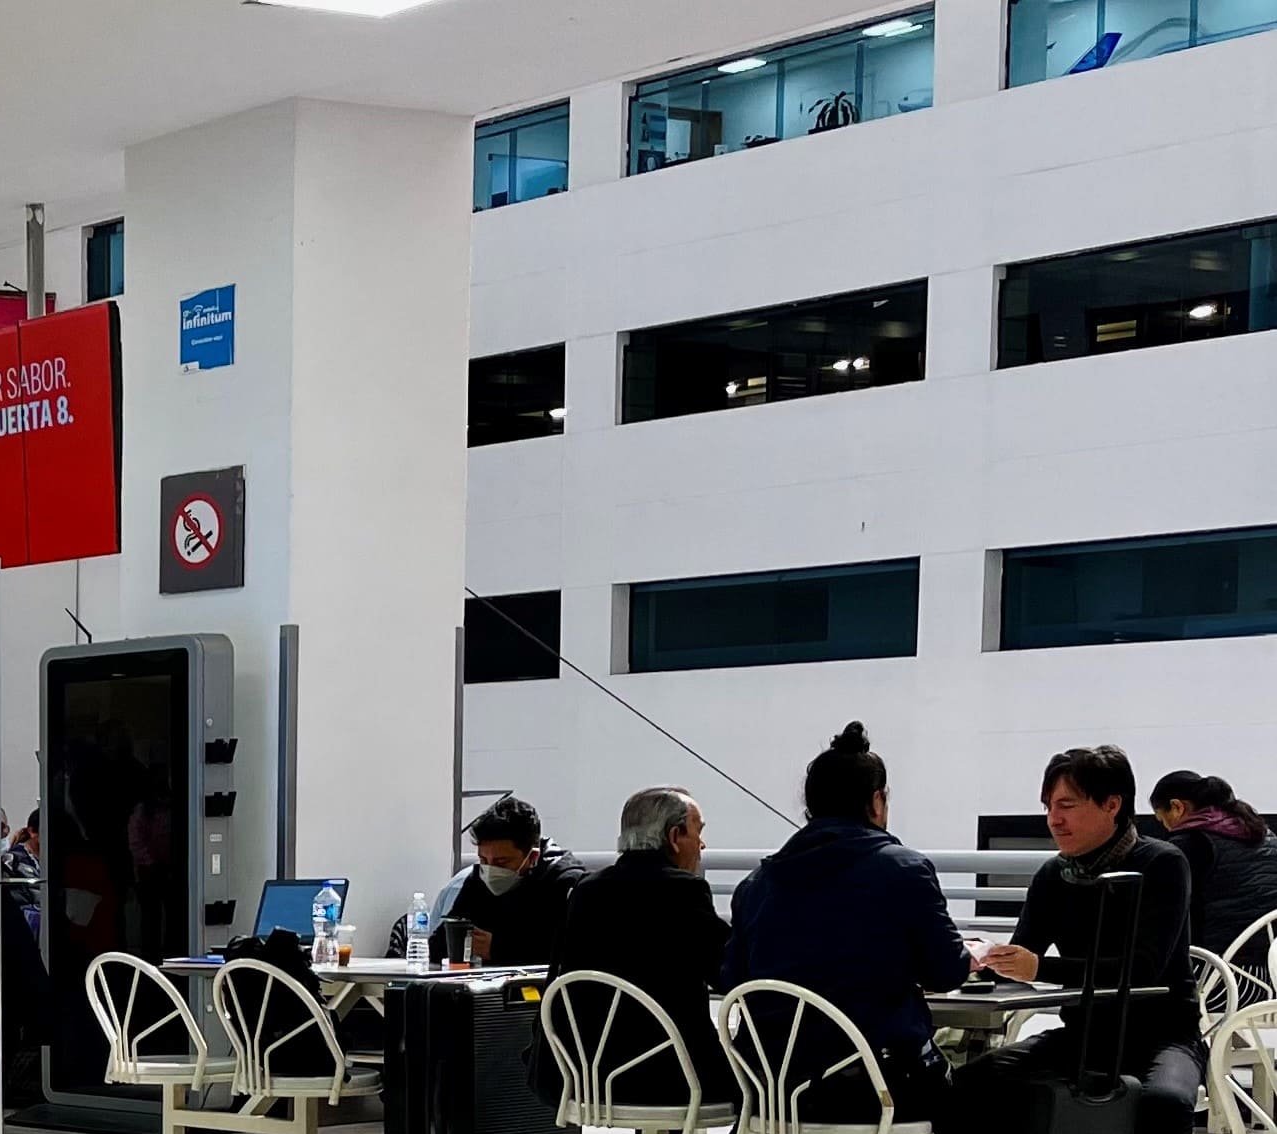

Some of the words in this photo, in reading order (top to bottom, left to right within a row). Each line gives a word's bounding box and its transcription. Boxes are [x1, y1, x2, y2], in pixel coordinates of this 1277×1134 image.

[182, 311, 232, 330] infinitum
[6, 357, 72, 399] SABOR.
[56, 395, 75, 425] 8.
